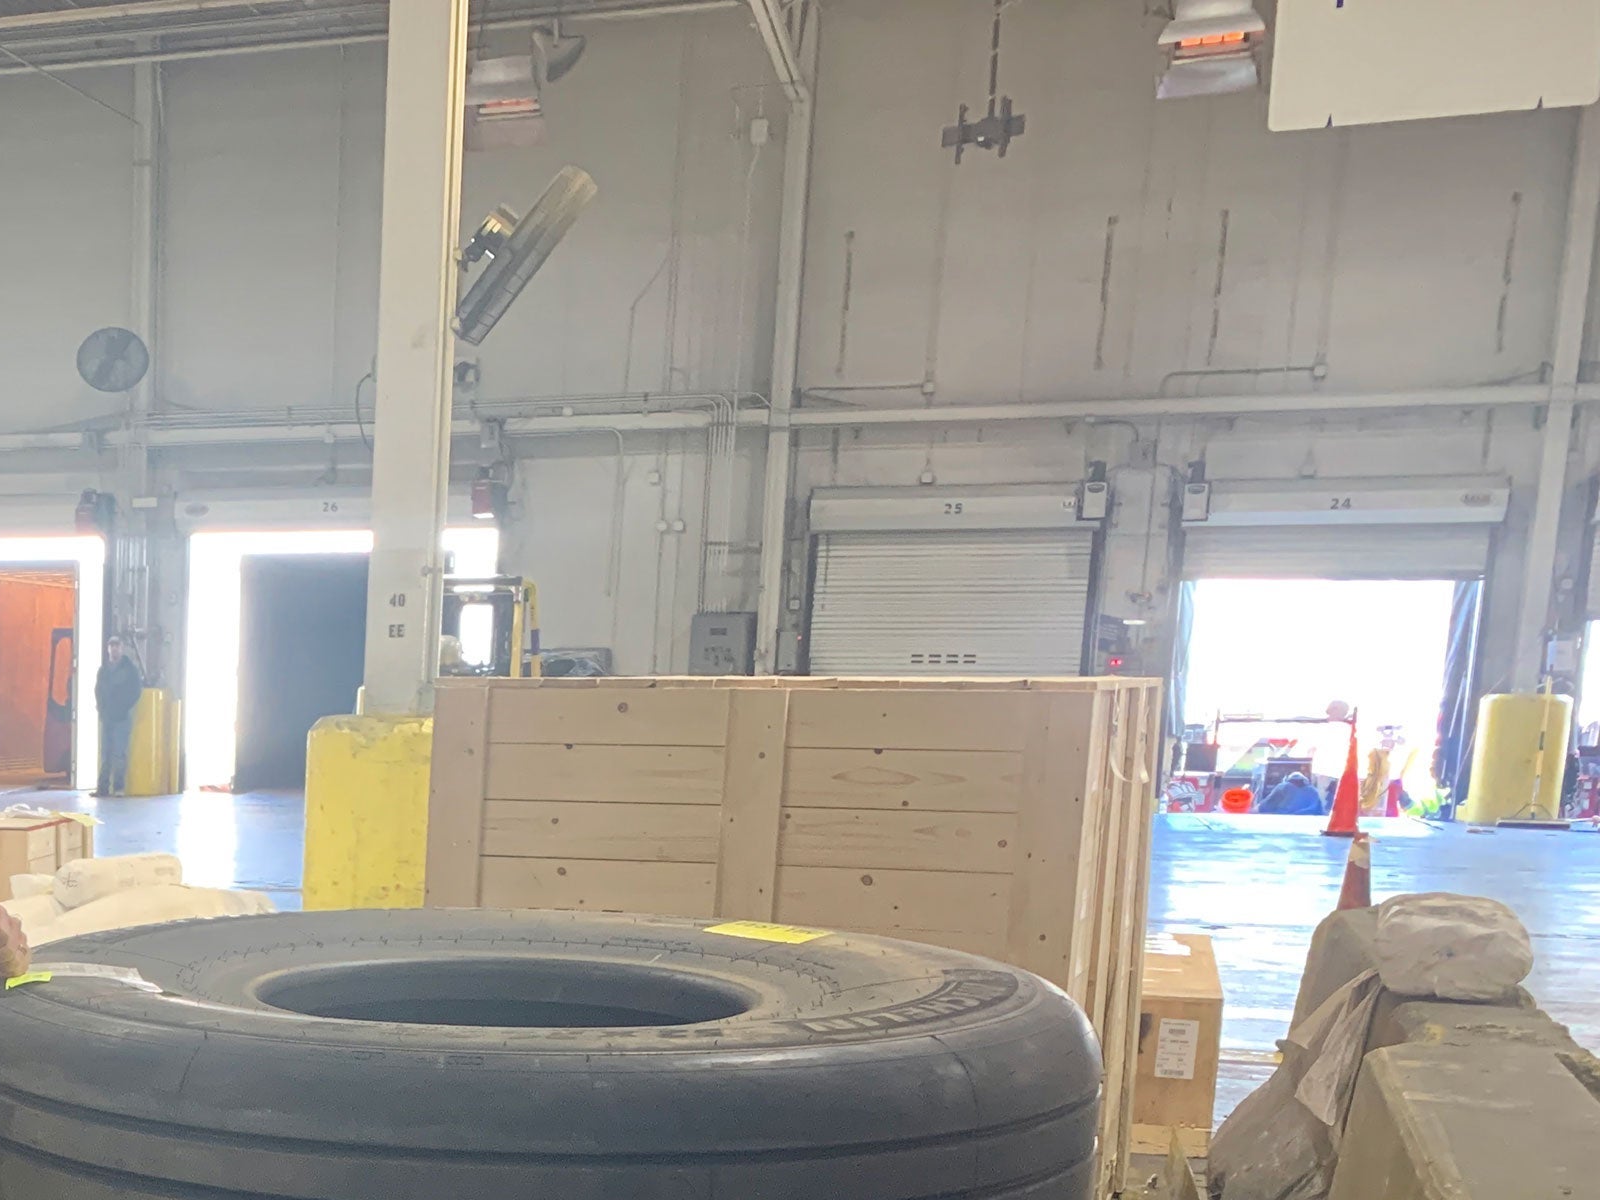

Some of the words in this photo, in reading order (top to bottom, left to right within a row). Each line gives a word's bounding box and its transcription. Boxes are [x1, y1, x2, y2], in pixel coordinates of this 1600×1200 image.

[322, 502, 339, 512] 26
[943, 503, 963, 514] 25
[1329, 498, 1353, 510] 24
[389, 593, 406, 608] 40
[388, 624, 405, 638] EE
